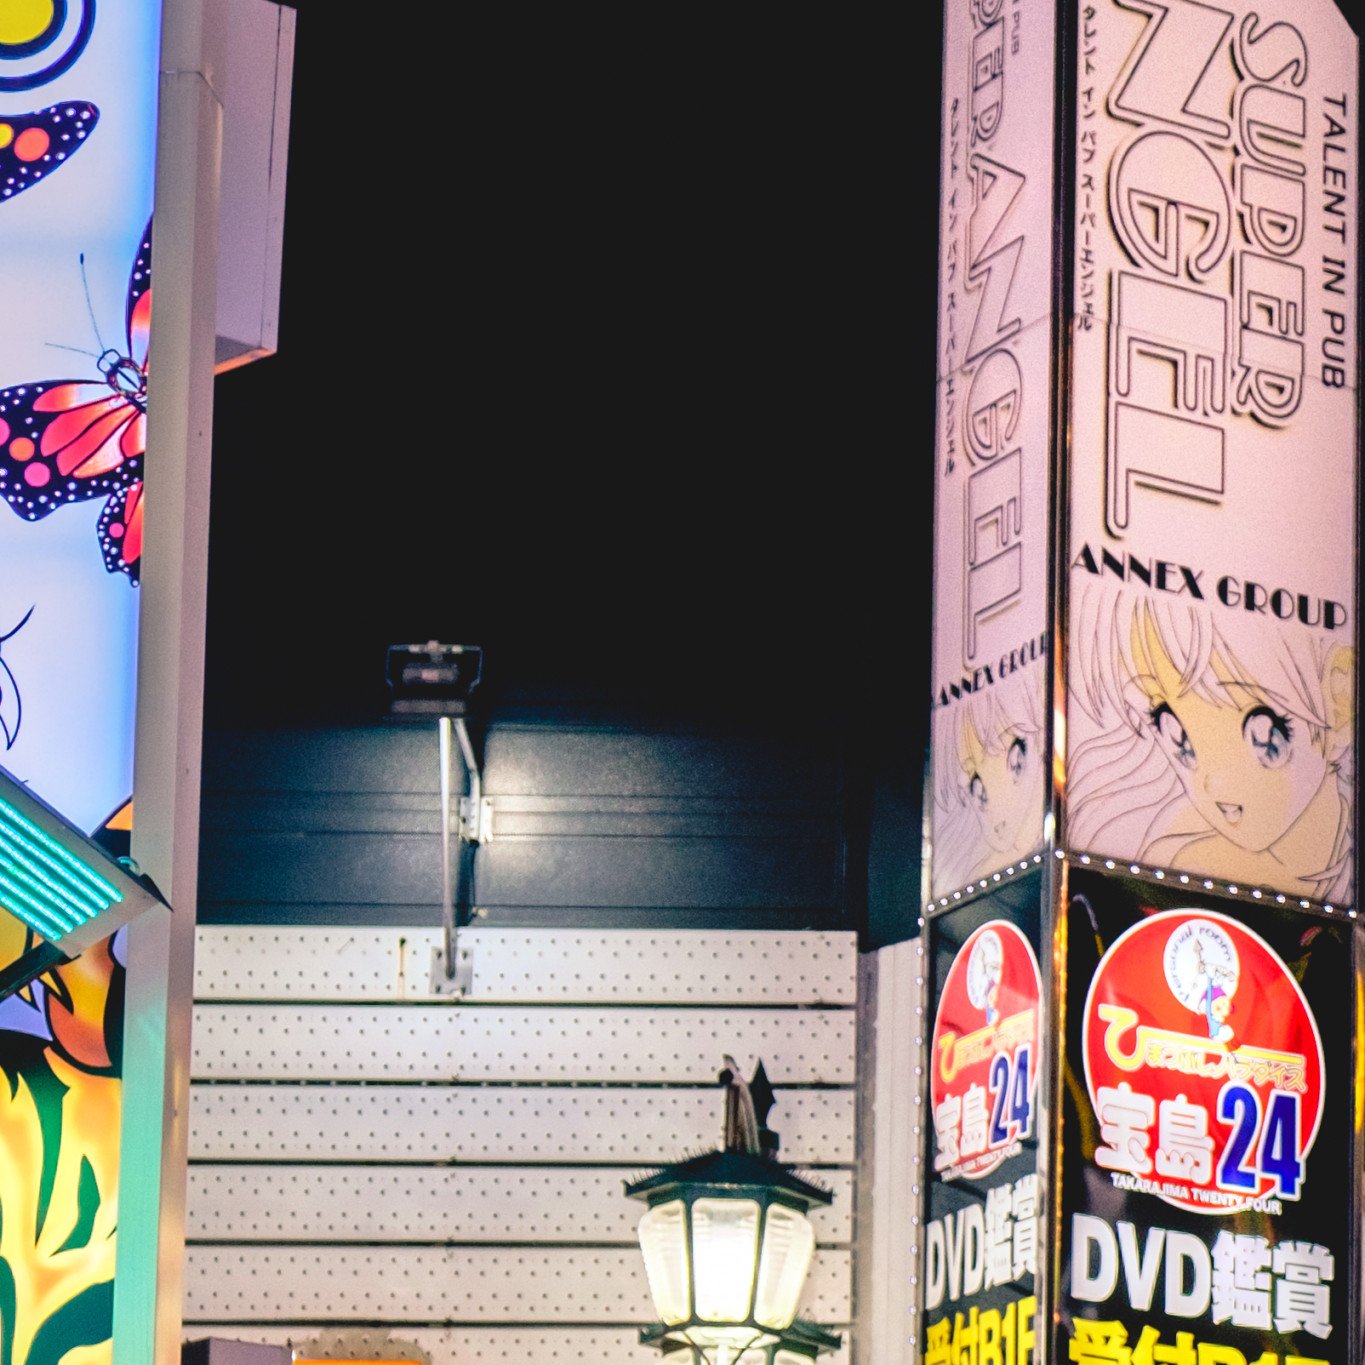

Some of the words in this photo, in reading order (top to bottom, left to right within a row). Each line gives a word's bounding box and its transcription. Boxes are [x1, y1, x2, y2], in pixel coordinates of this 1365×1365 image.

[1233, 12, 1309, 430] SUPER
[1321, 94, 1348, 243] TALENT
[1322, 256, 1347, 295] IN
[1321, 309, 1346, 390] PUB
[1071, 543, 1205, 602] ANNEX
[1216, 575, 1349, 631] GROUP
[925, 1173, 1038, 1312] DVD鑑賞
[1070, 1212, 1336, 1340] DVD鑑賞
